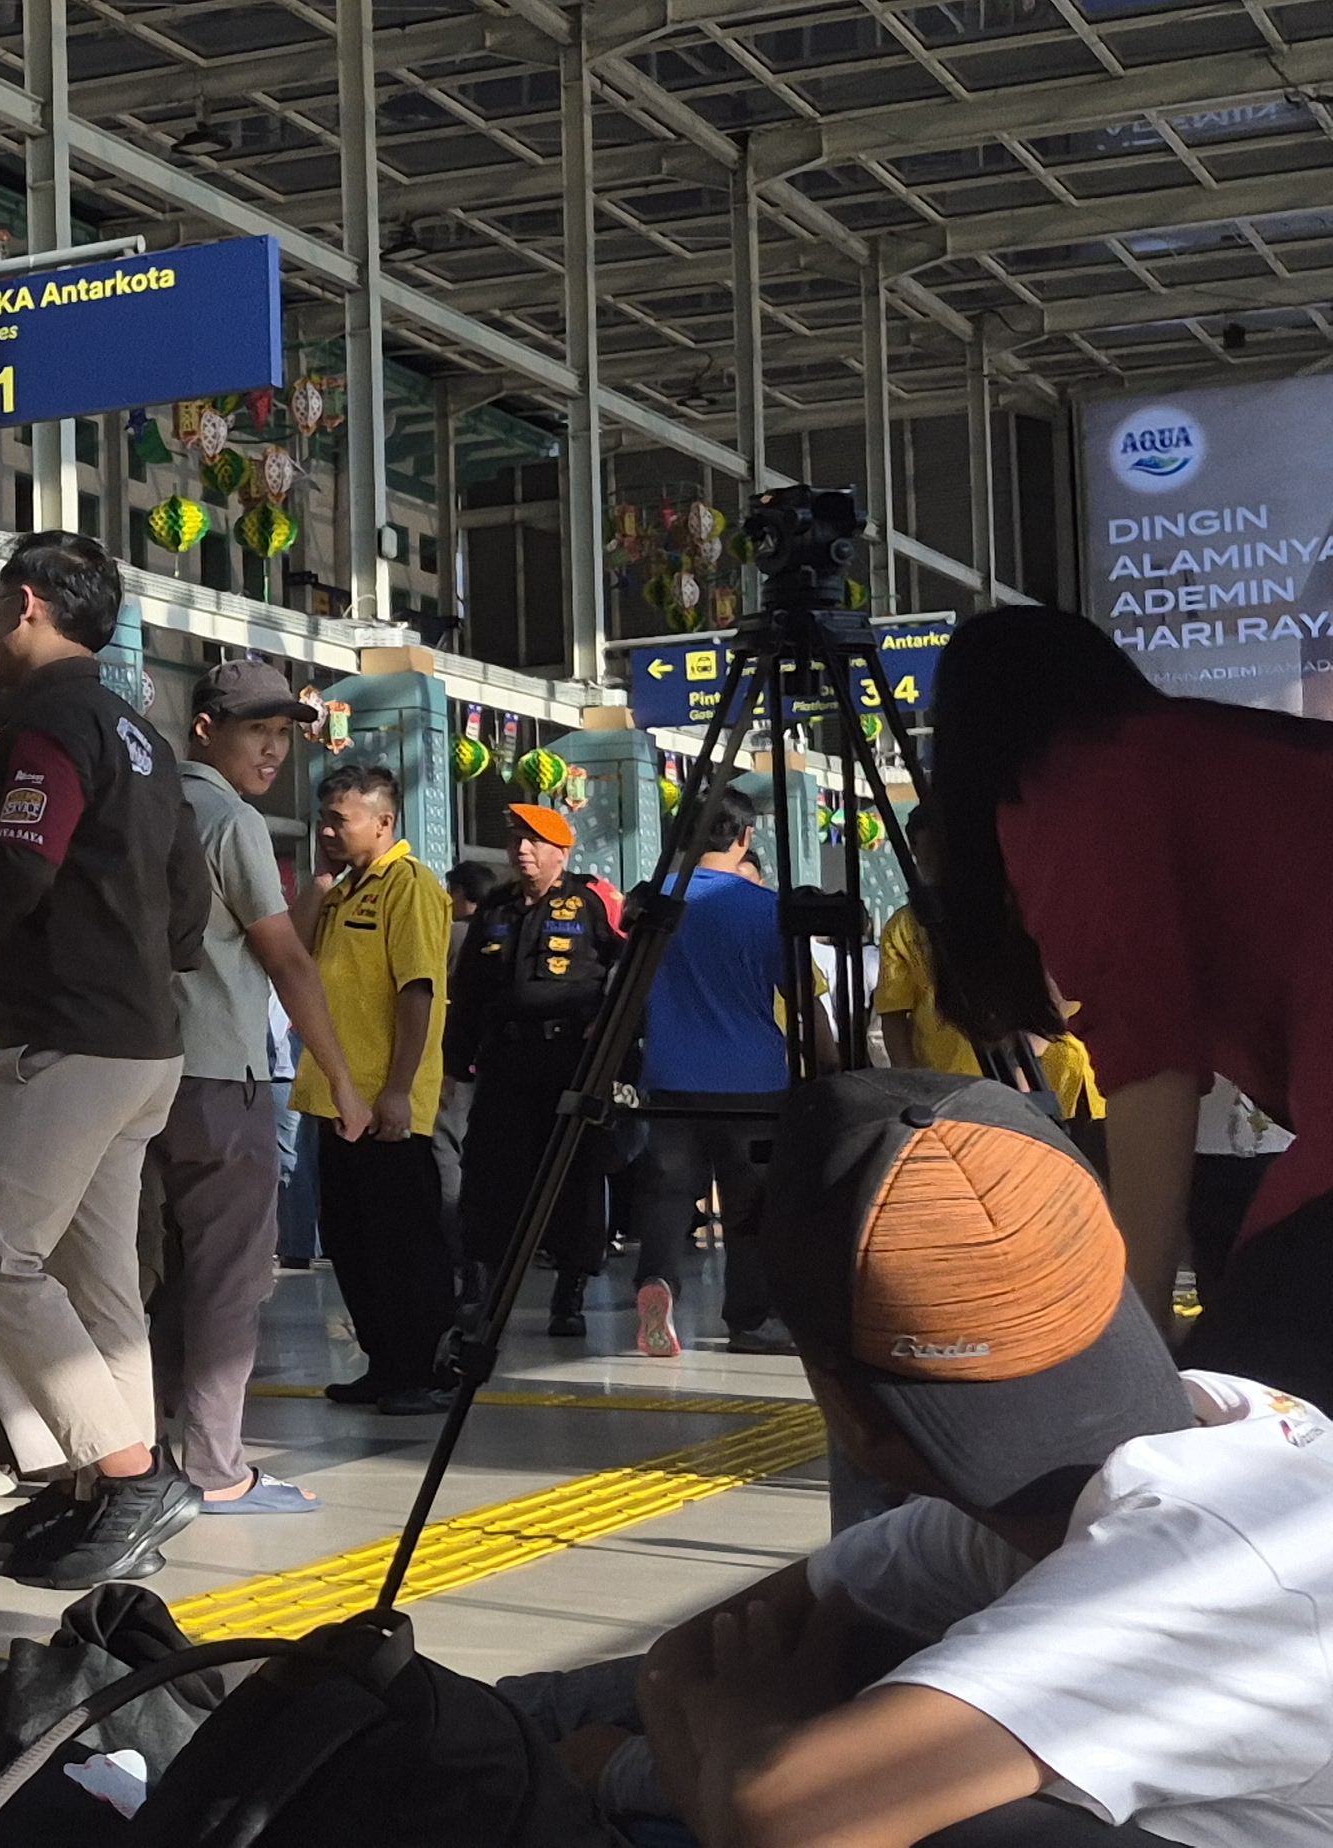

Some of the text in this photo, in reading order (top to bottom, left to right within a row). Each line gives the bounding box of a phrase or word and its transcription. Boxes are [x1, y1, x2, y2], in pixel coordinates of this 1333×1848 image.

[40, 264, 176, 309] Antarkota
[1120, 425, 1193, 454] AQUA
[1108, 504, 1269, 545] DINGIN
[1108, 534, 1333, 582] ALAMINYA
[1109, 576, 1296, 618] ADEMIN
[881, 630, 951, 650] Antarko
[1113, 610, 1333, 652] HARI RAY
[689, 690, 722, 707] Pint
[860, 678, 881, 707] 3
[893, 675, 921, 704] 4
